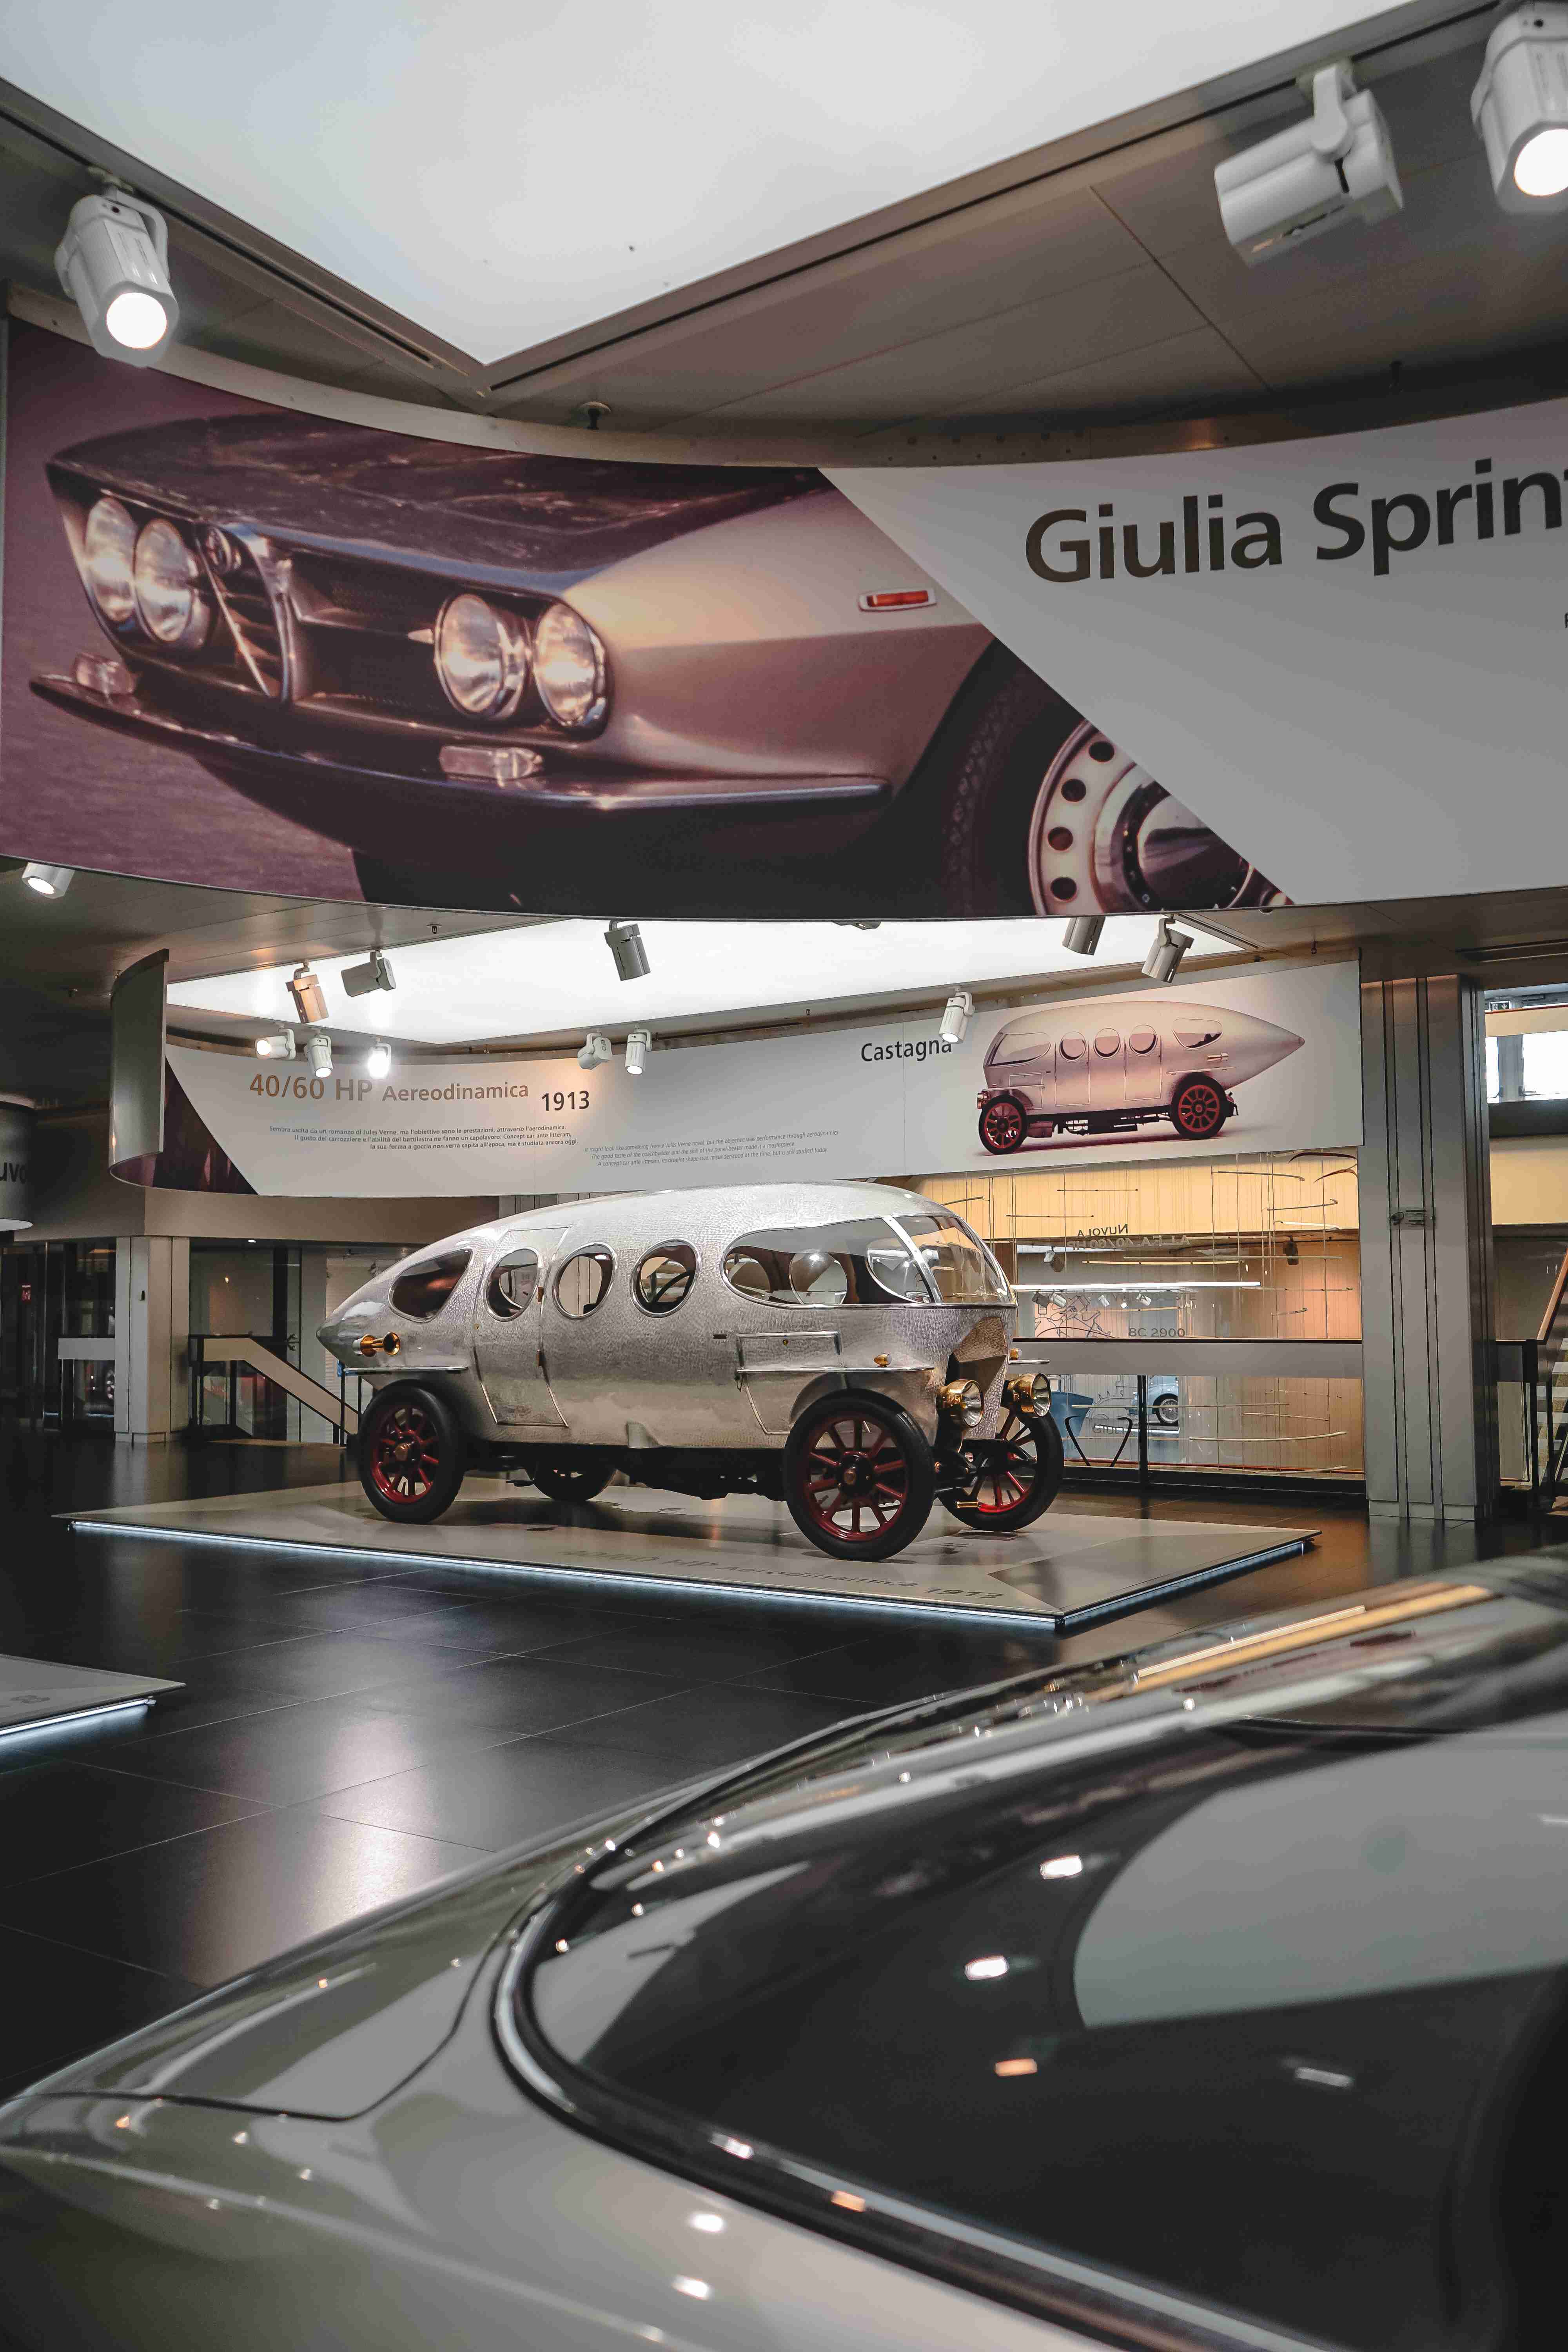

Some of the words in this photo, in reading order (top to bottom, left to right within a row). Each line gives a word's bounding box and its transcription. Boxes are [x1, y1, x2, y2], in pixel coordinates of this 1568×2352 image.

[1025, 493, 1283, 583] Giulia
[1313, 457, 1568, 576] Sprin
[861, 1039, 952, 1062] Castagna
[250, 1074, 325, 1099] 40/60
[336, 1078, 373, 1101] HP
[382, 1081, 528, 1101] Aereodinamica
[541, 1090, 590, 1111] 1913
[1129, 1327, 1147, 1337] 8C
[1151, 1328, 1186, 1337] 2900
[1092, 1424, 1134, 1436] GIULI
[716, 1565, 919, 1587] Aerodinamica
[923, 1586, 1006, 1600] 1913
